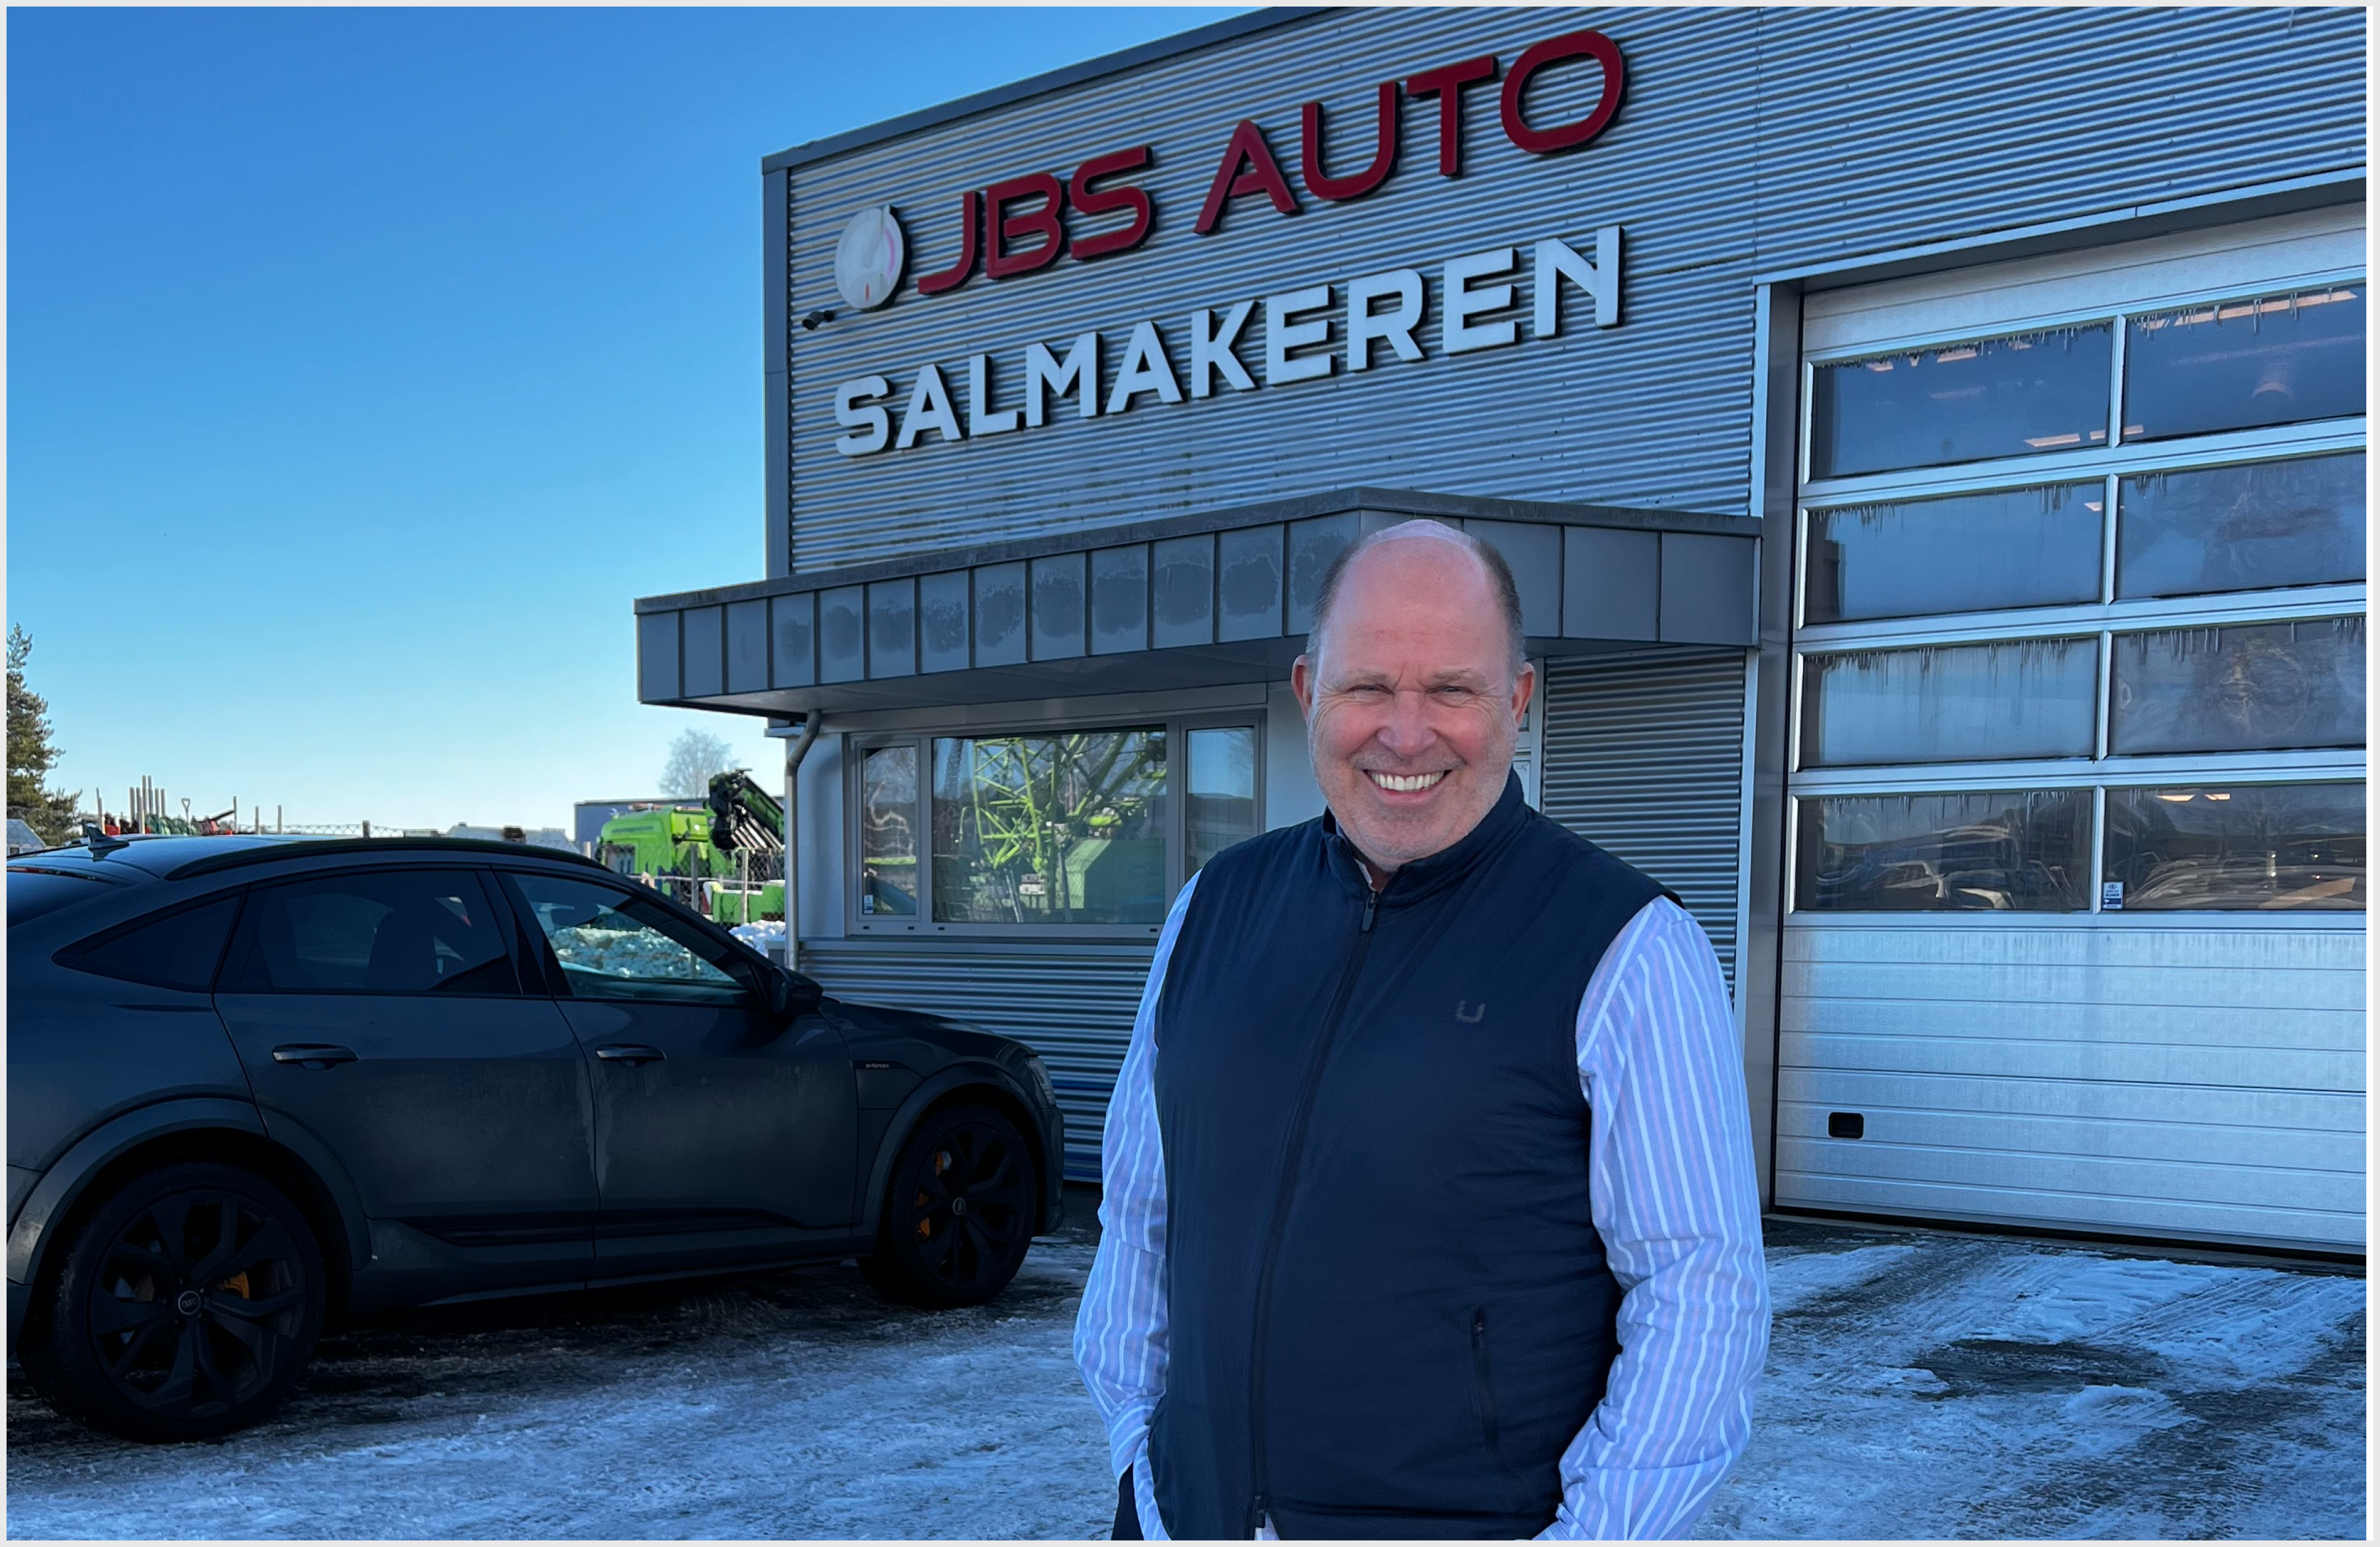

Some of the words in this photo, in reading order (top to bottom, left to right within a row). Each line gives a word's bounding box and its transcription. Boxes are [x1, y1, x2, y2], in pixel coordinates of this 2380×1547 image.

[917, 145, 1153, 296] JBS
[1194, 29, 1627, 235] AUTO
[834, 224, 1625, 456] SALMAKEREN
